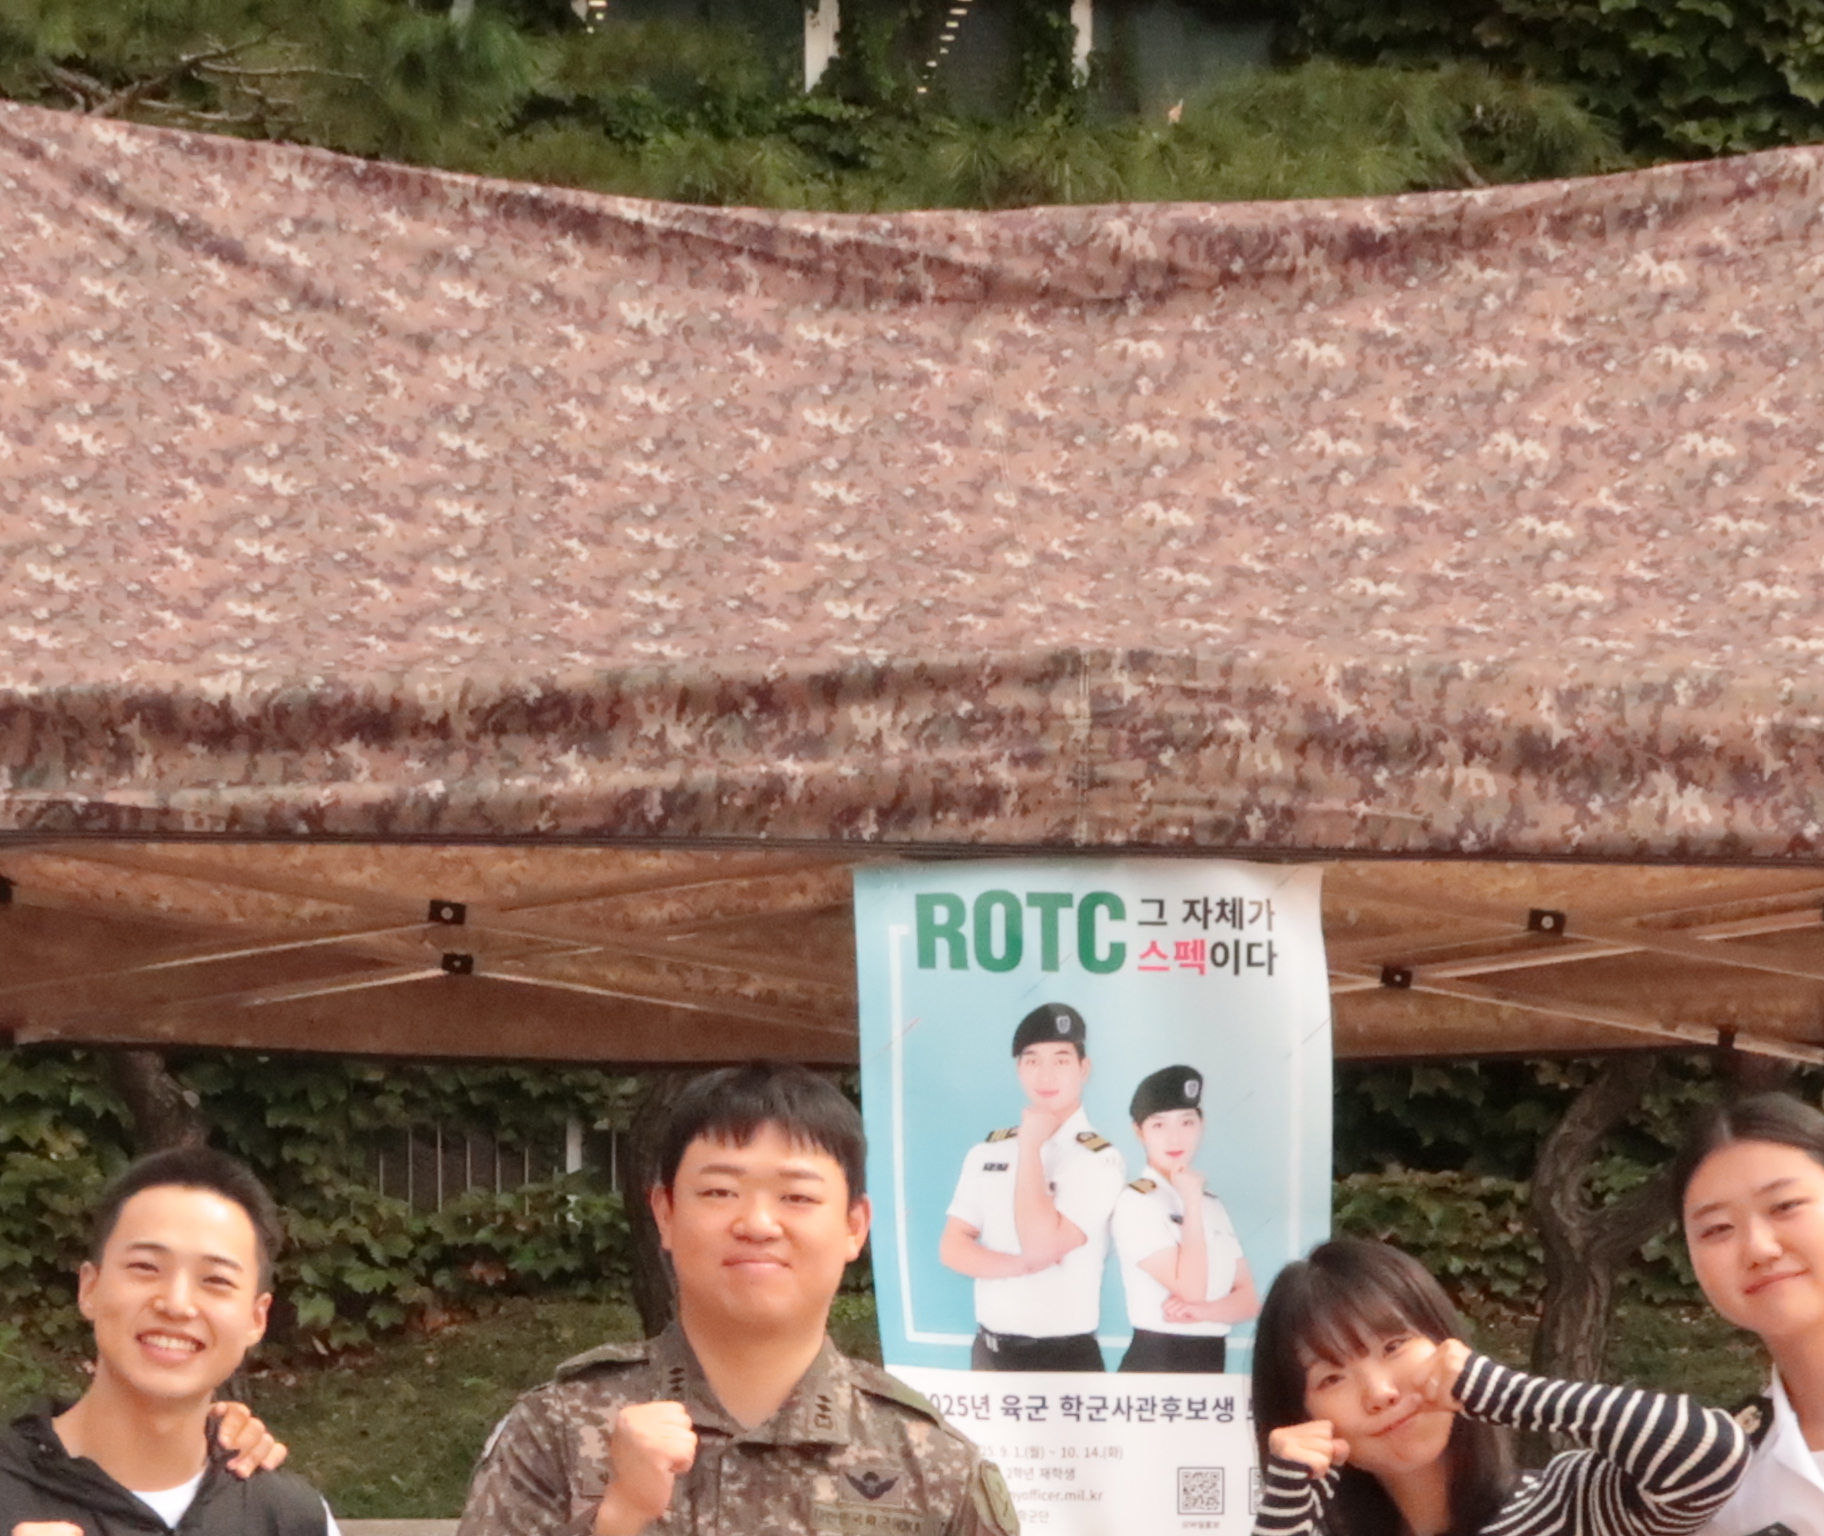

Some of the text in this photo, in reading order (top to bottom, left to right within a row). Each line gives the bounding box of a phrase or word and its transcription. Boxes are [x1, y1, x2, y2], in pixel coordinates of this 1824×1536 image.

[916, 889, 1127, 975] ROTC
[1137, 896, 1276, 932] 그 자체가
[1137, 938, 1278, 976] 스펙이다
[1000, 1394, 1049, 1422] 육군
[1059, 1394, 1234, 1423] 학군사관후보생
